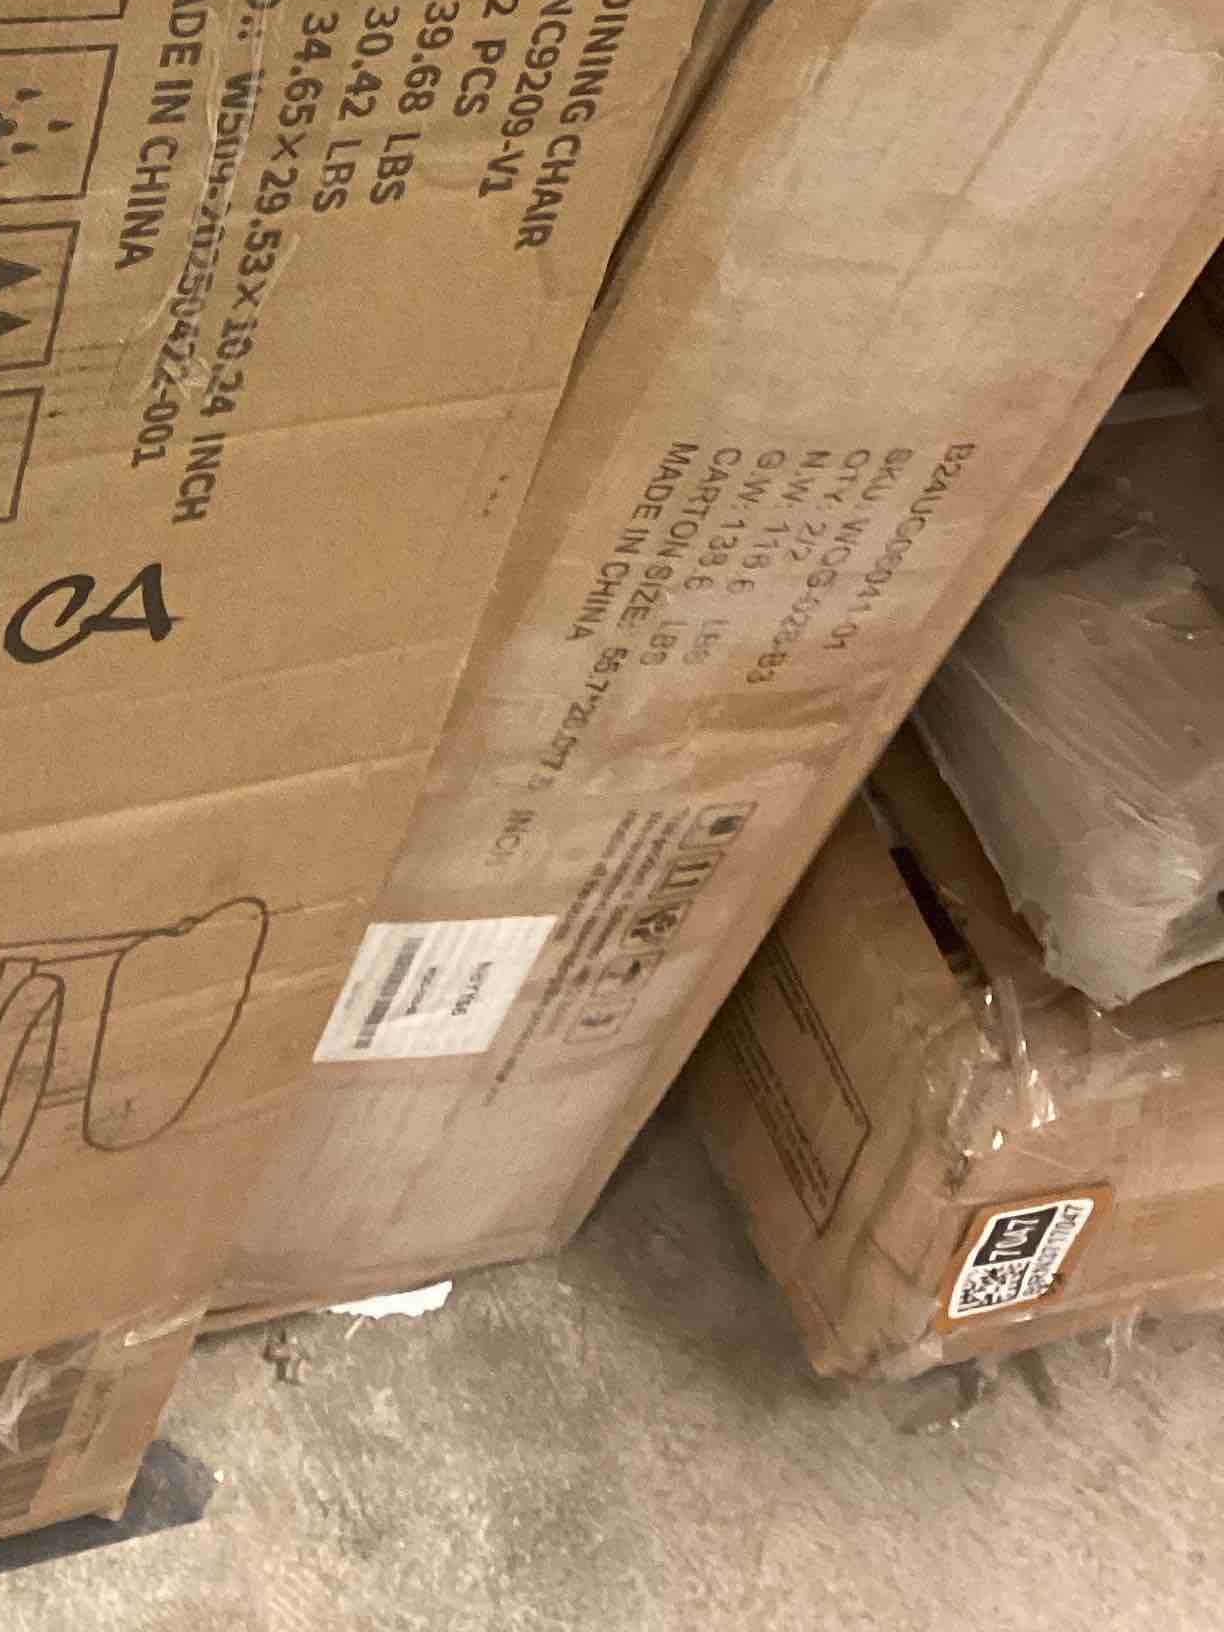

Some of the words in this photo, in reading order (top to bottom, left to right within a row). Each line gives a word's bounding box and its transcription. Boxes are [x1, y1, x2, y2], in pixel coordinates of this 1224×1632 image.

[337, 5, 401, 121] 30.42
[397, 0, 461, 115] 39.68
[453, 39, 508, 118] PCS
[147, 78, 193, 125] IN
[114, 134, 179, 270] CHINA
[311, 138, 363, 214] LBS
[369, 130, 421, 206] LBS
[513, 134, 582, 251] CHAIR
[171, 431, 226, 525] INCH
[631, 441, 699, 521] MADE
[656, 447, 743, 559] CARTON
[613, 527, 650, 555] IN
[3, 562, 184, 665] CA
[564, 561, 630, 641] CHINA
